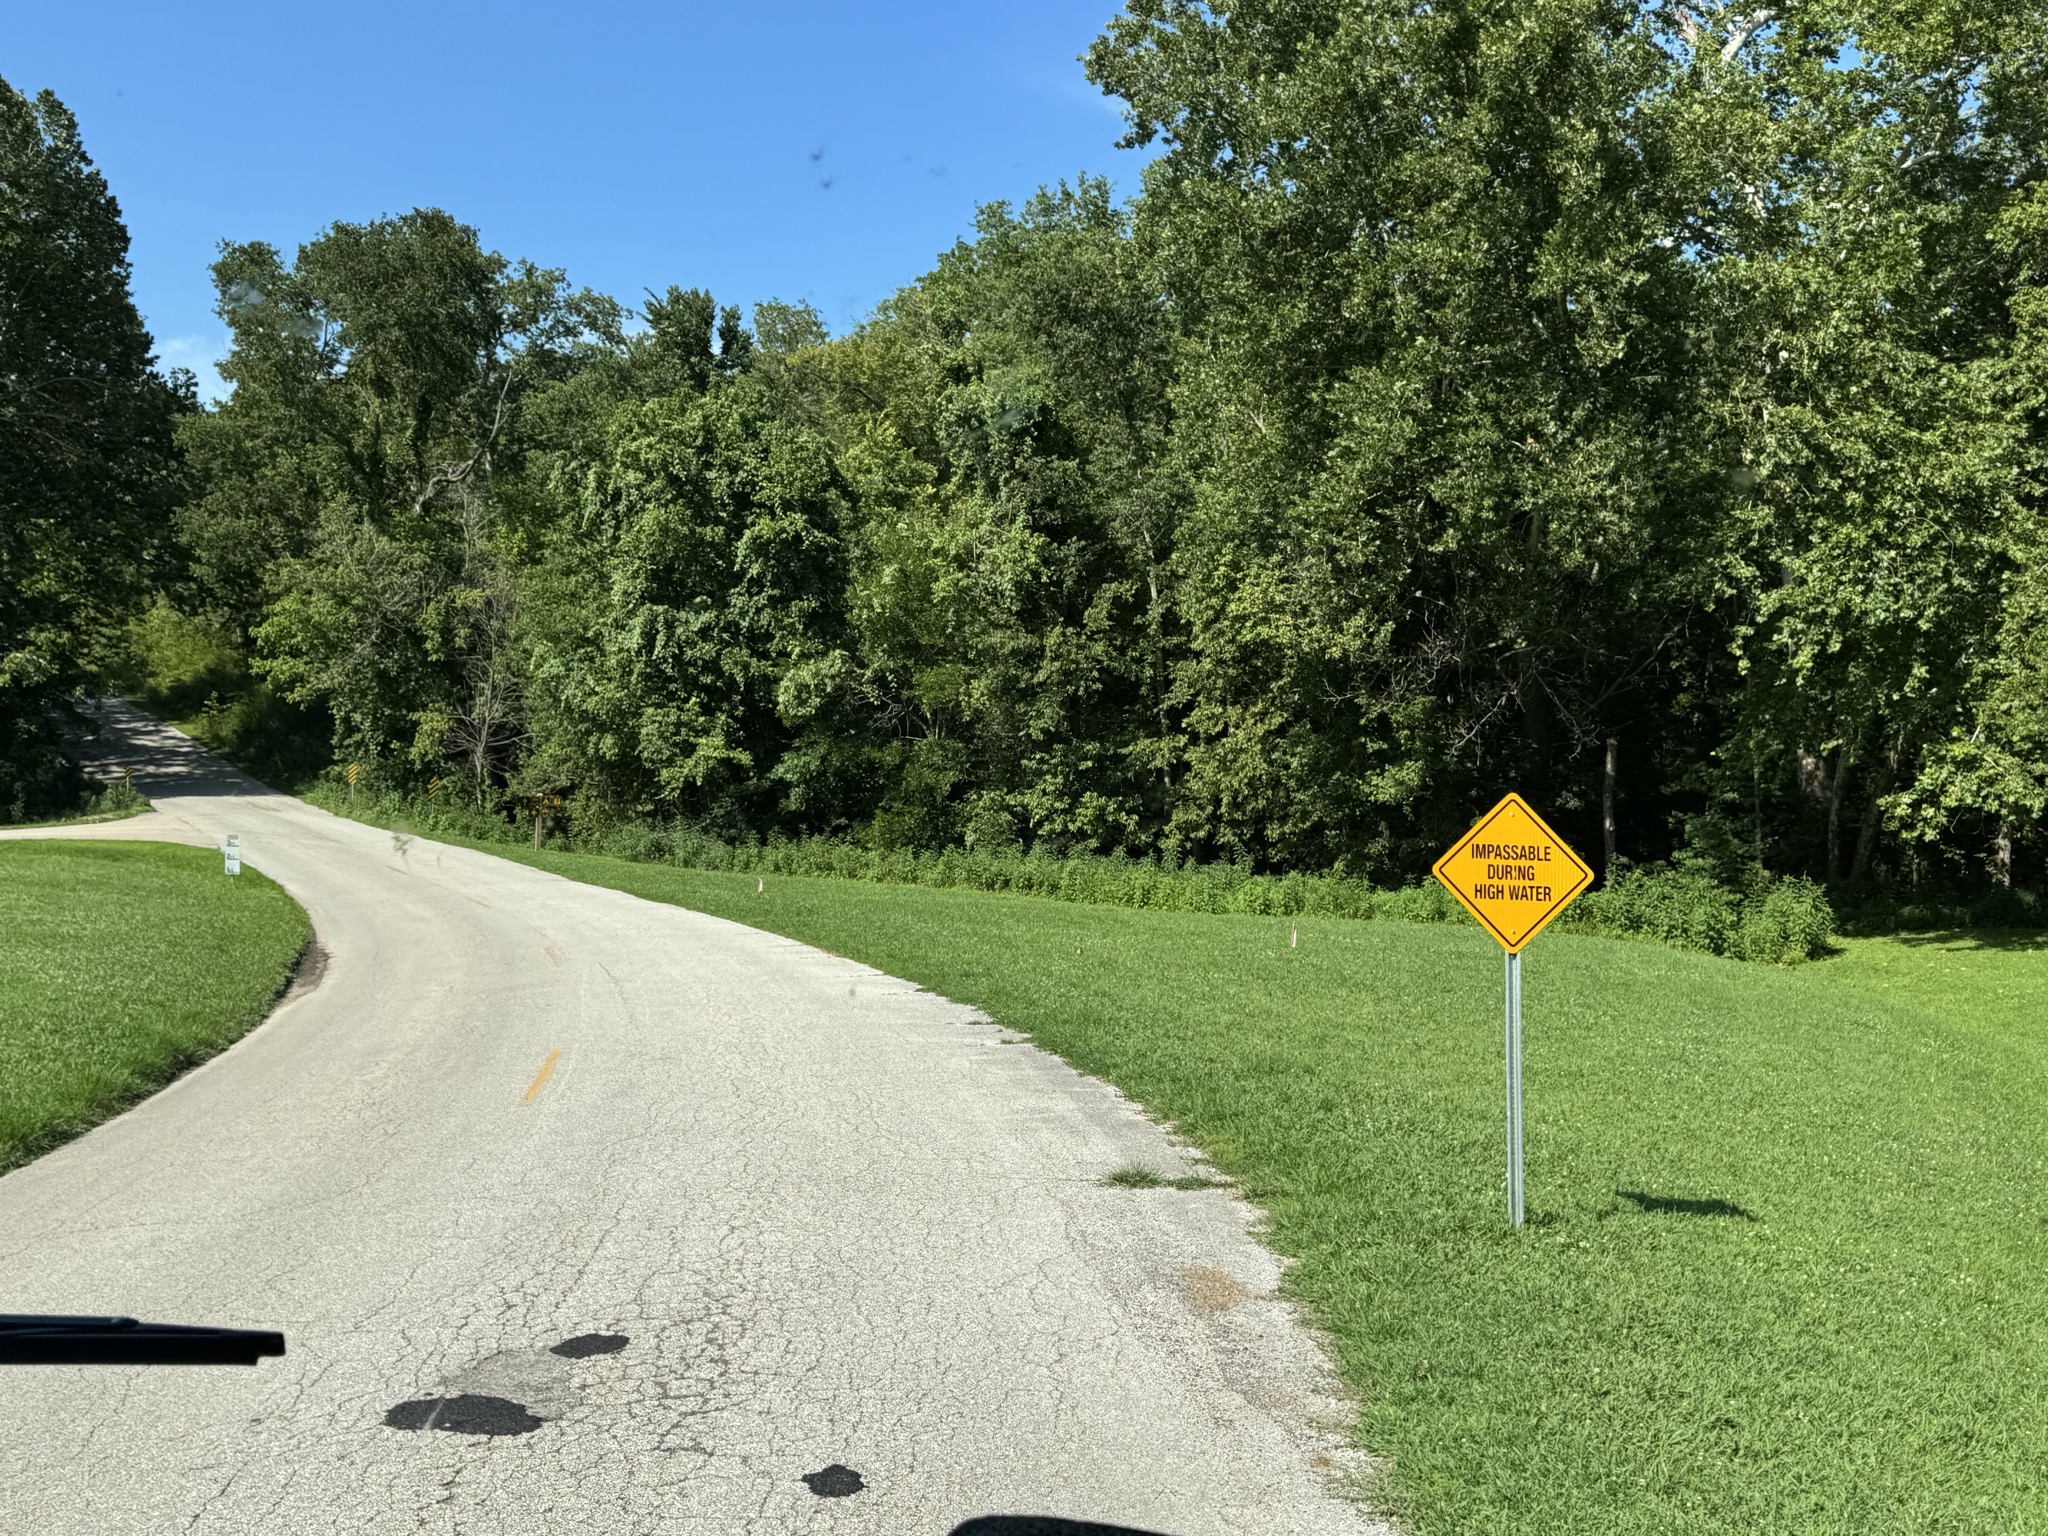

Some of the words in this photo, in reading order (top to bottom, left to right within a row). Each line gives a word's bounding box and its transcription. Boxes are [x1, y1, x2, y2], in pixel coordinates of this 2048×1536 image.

[1471, 844, 1551, 861] IMPASSABLE
[1487, 864, 1535, 881] DURING
[1474, 884, 1504, 900] HIGH
[1508, 885, 1552, 902] WATER
